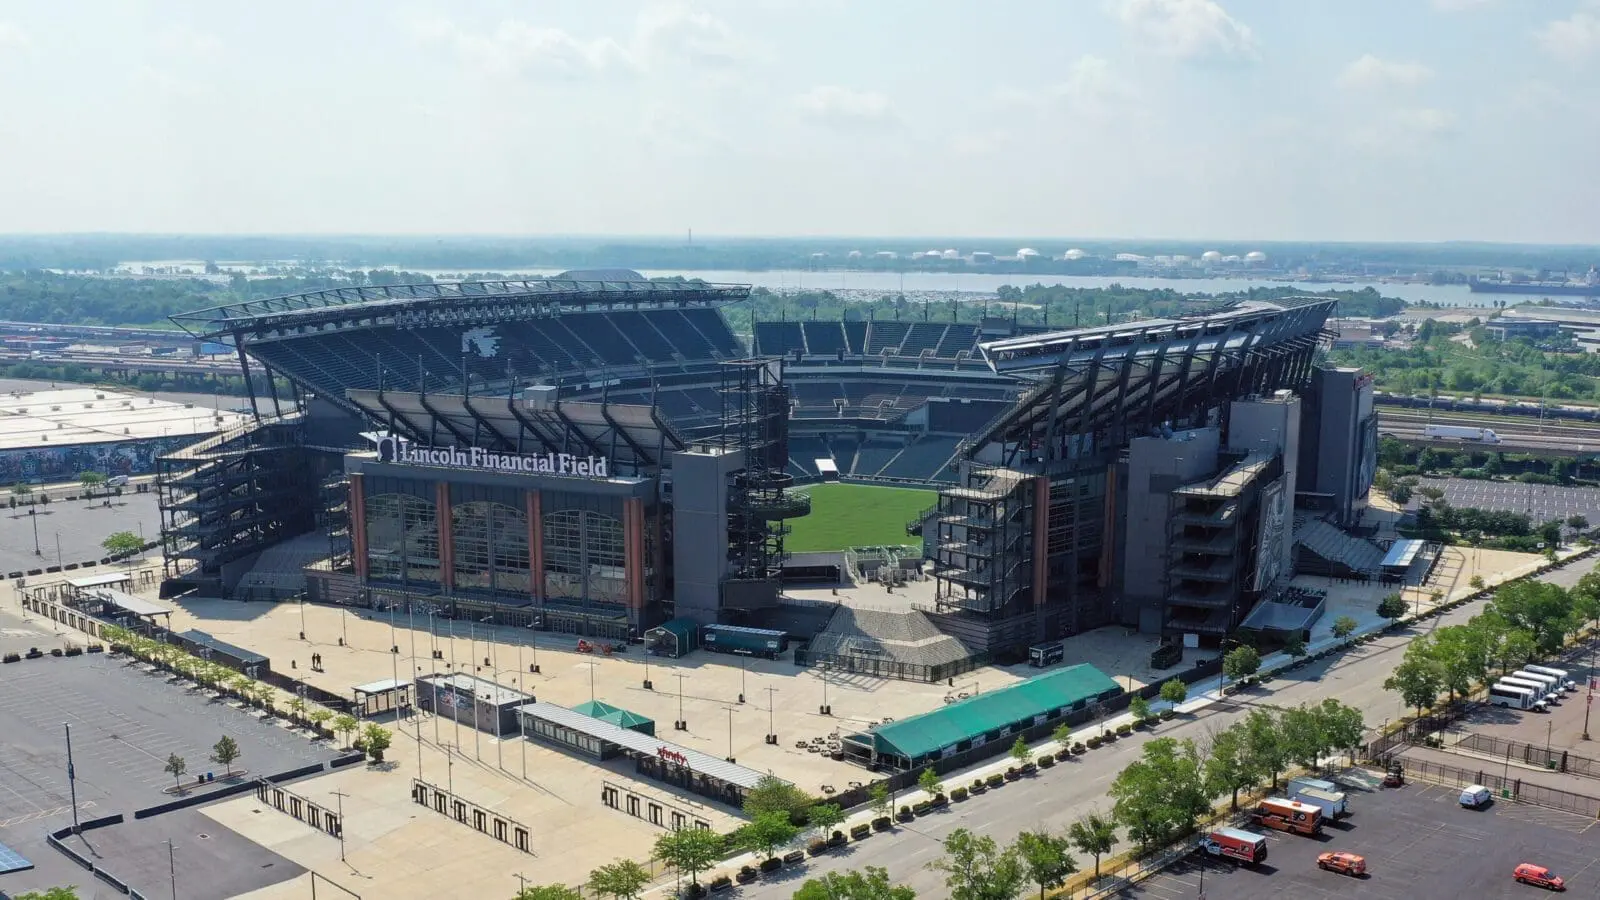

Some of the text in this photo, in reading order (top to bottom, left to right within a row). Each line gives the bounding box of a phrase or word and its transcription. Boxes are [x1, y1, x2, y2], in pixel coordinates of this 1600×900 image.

[400, 441, 608, 477] Lincoln Financial Field
[656, 746, 688, 766] xfinity
